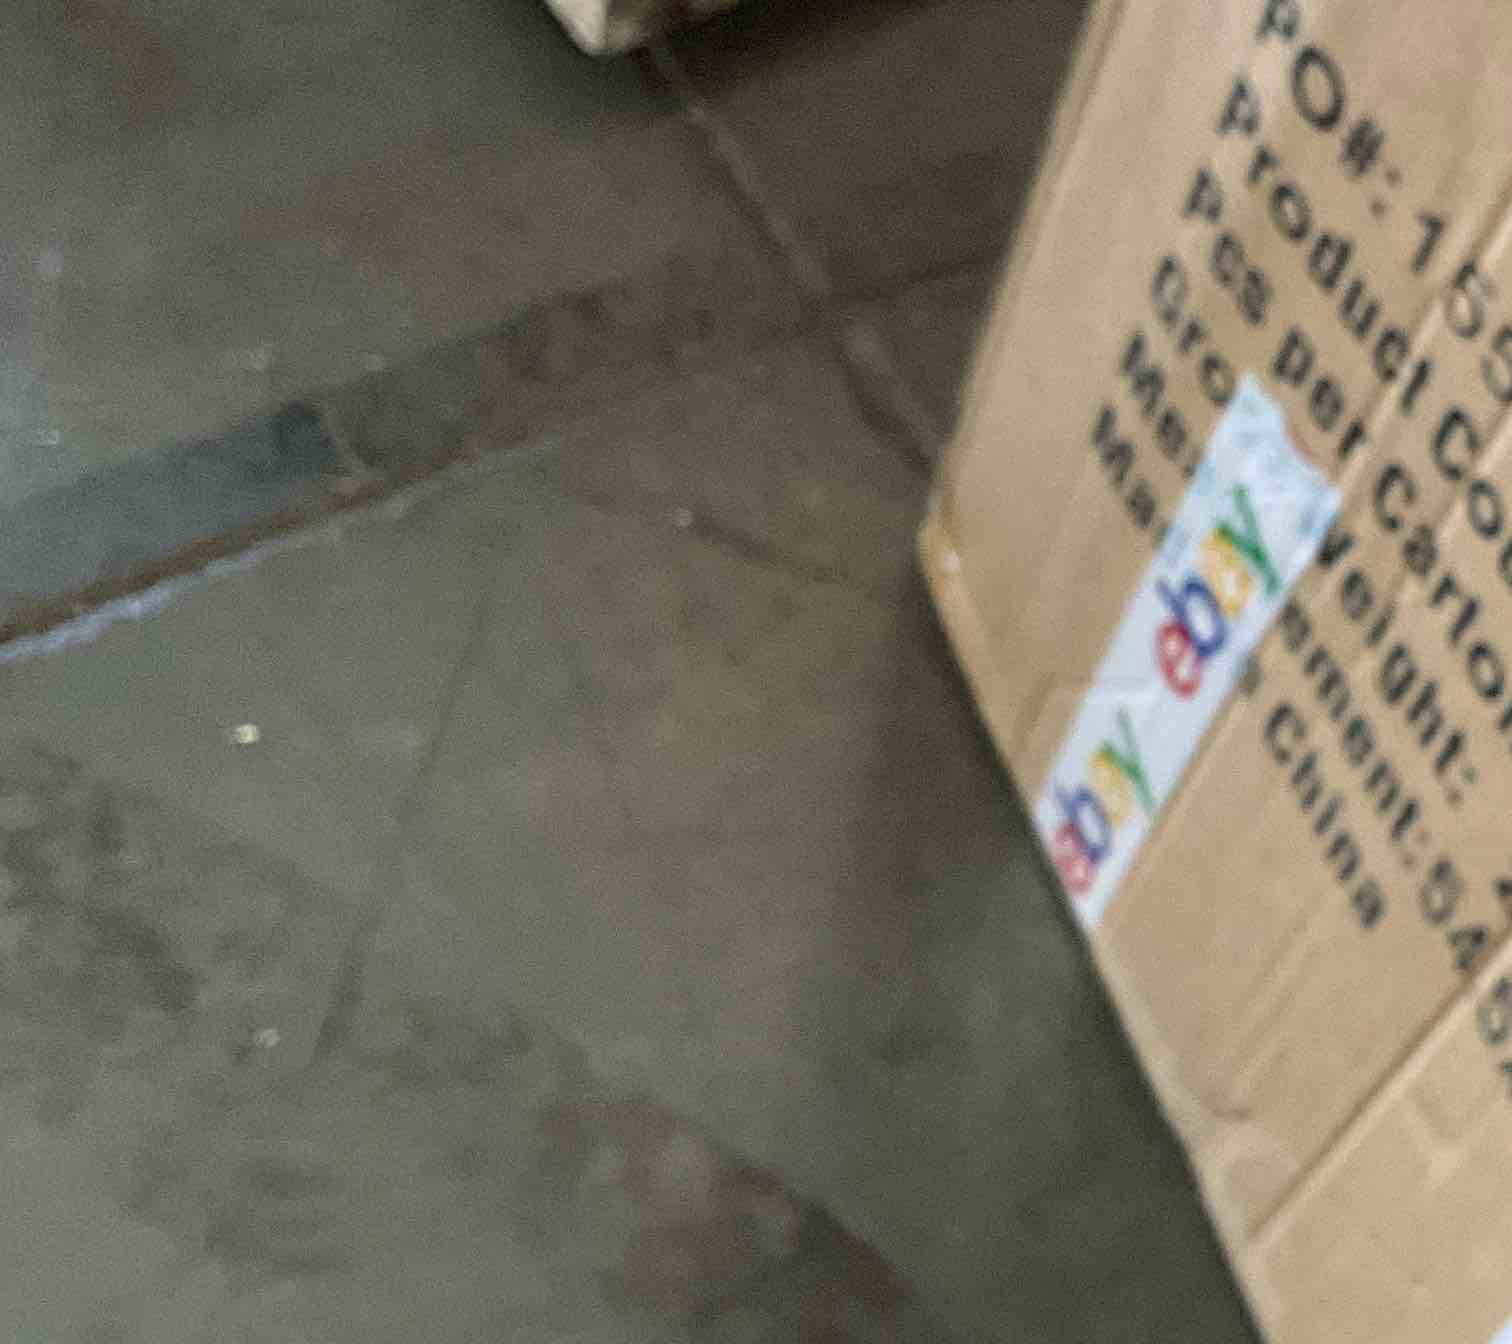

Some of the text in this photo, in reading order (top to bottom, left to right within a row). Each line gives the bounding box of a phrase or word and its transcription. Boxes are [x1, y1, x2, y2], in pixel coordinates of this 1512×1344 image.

[1217, 76, 1432, 418] Product
[1271, 324, 1369, 464] per
[1155, 482, 1282, 701] ebay
[1054, 706, 1157, 896] ebay
[1264, 699, 1386, 931] China
